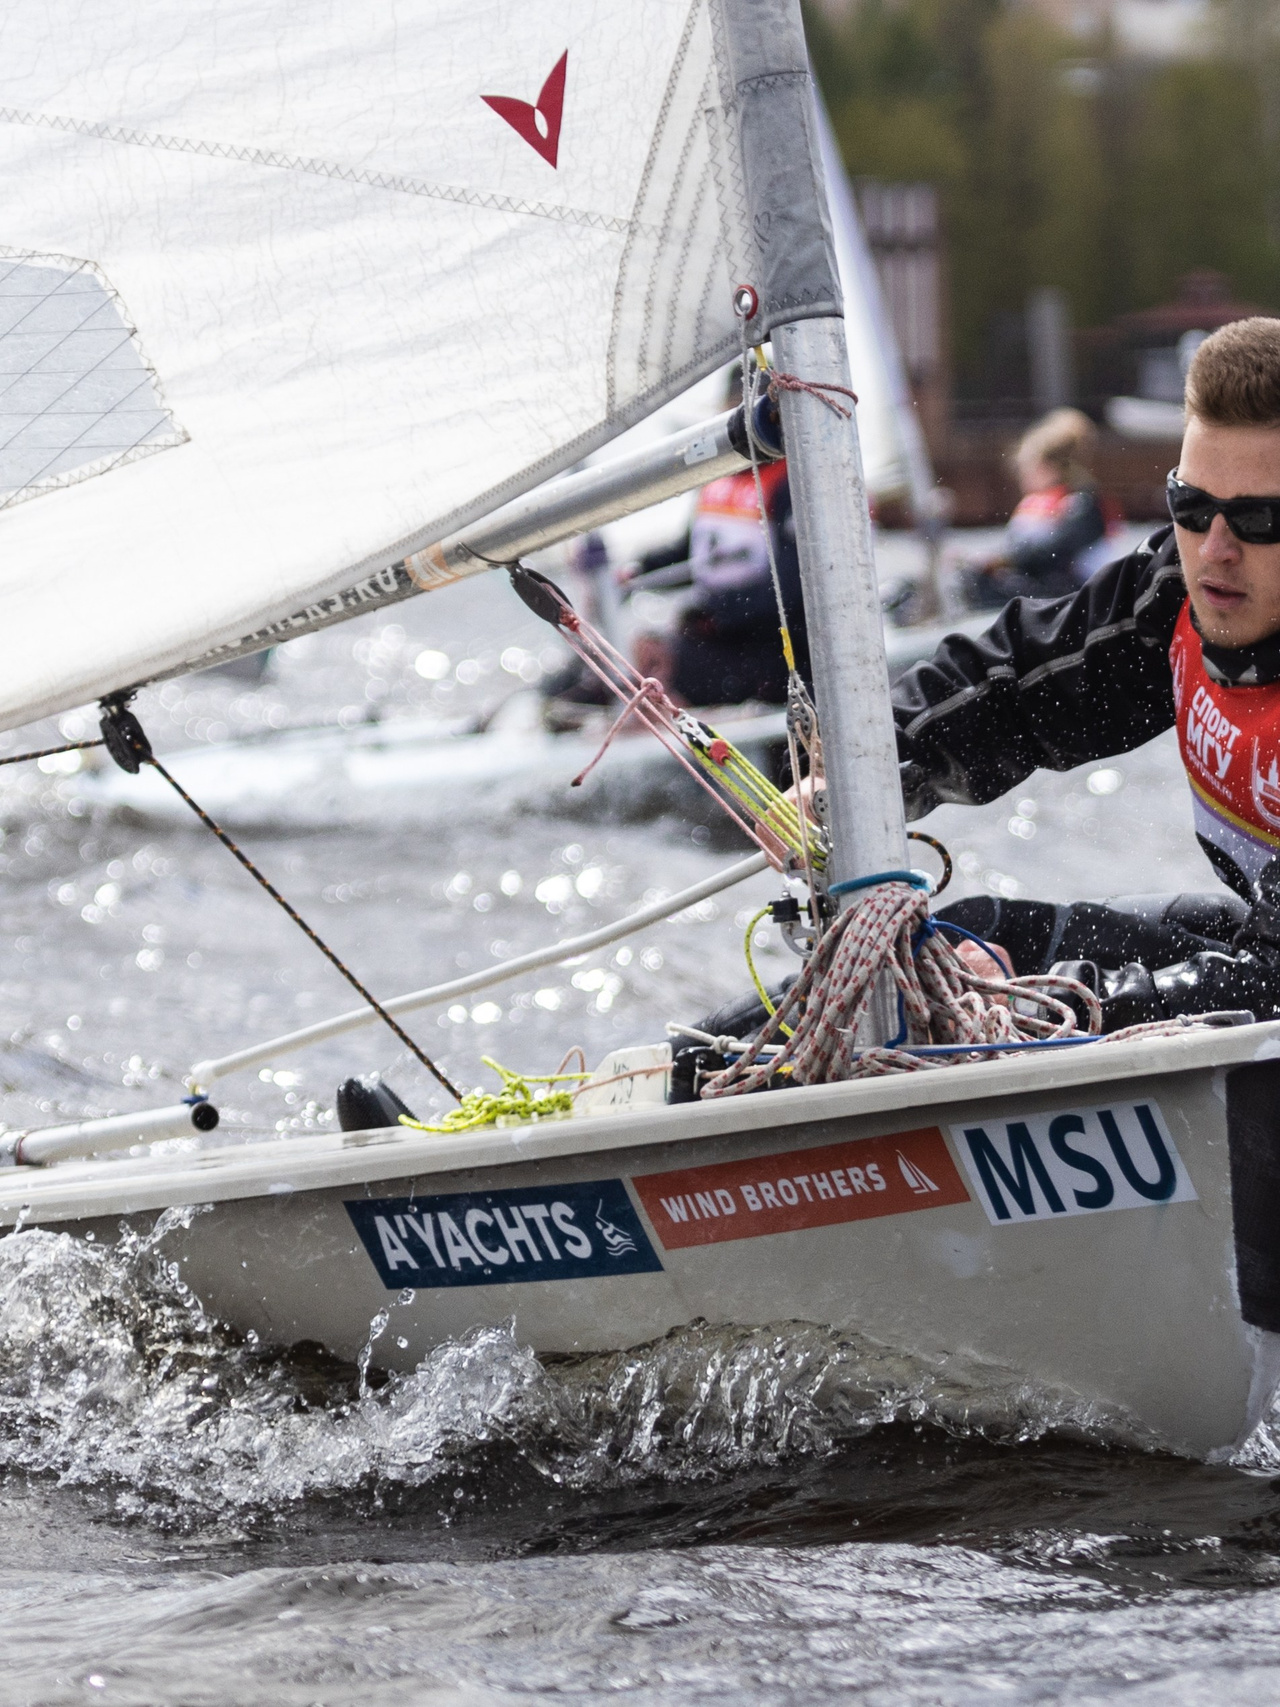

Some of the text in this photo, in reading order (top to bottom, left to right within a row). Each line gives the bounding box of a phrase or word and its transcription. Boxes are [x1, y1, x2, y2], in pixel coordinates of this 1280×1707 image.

[1186, 707, 1233, 779] МГУ
[1192, 686, 1241, 750] СПОРТ
[660, 1163, 887, 1223] WIND BROTHERS
[963, 1104, 1177, 1220] MSU
